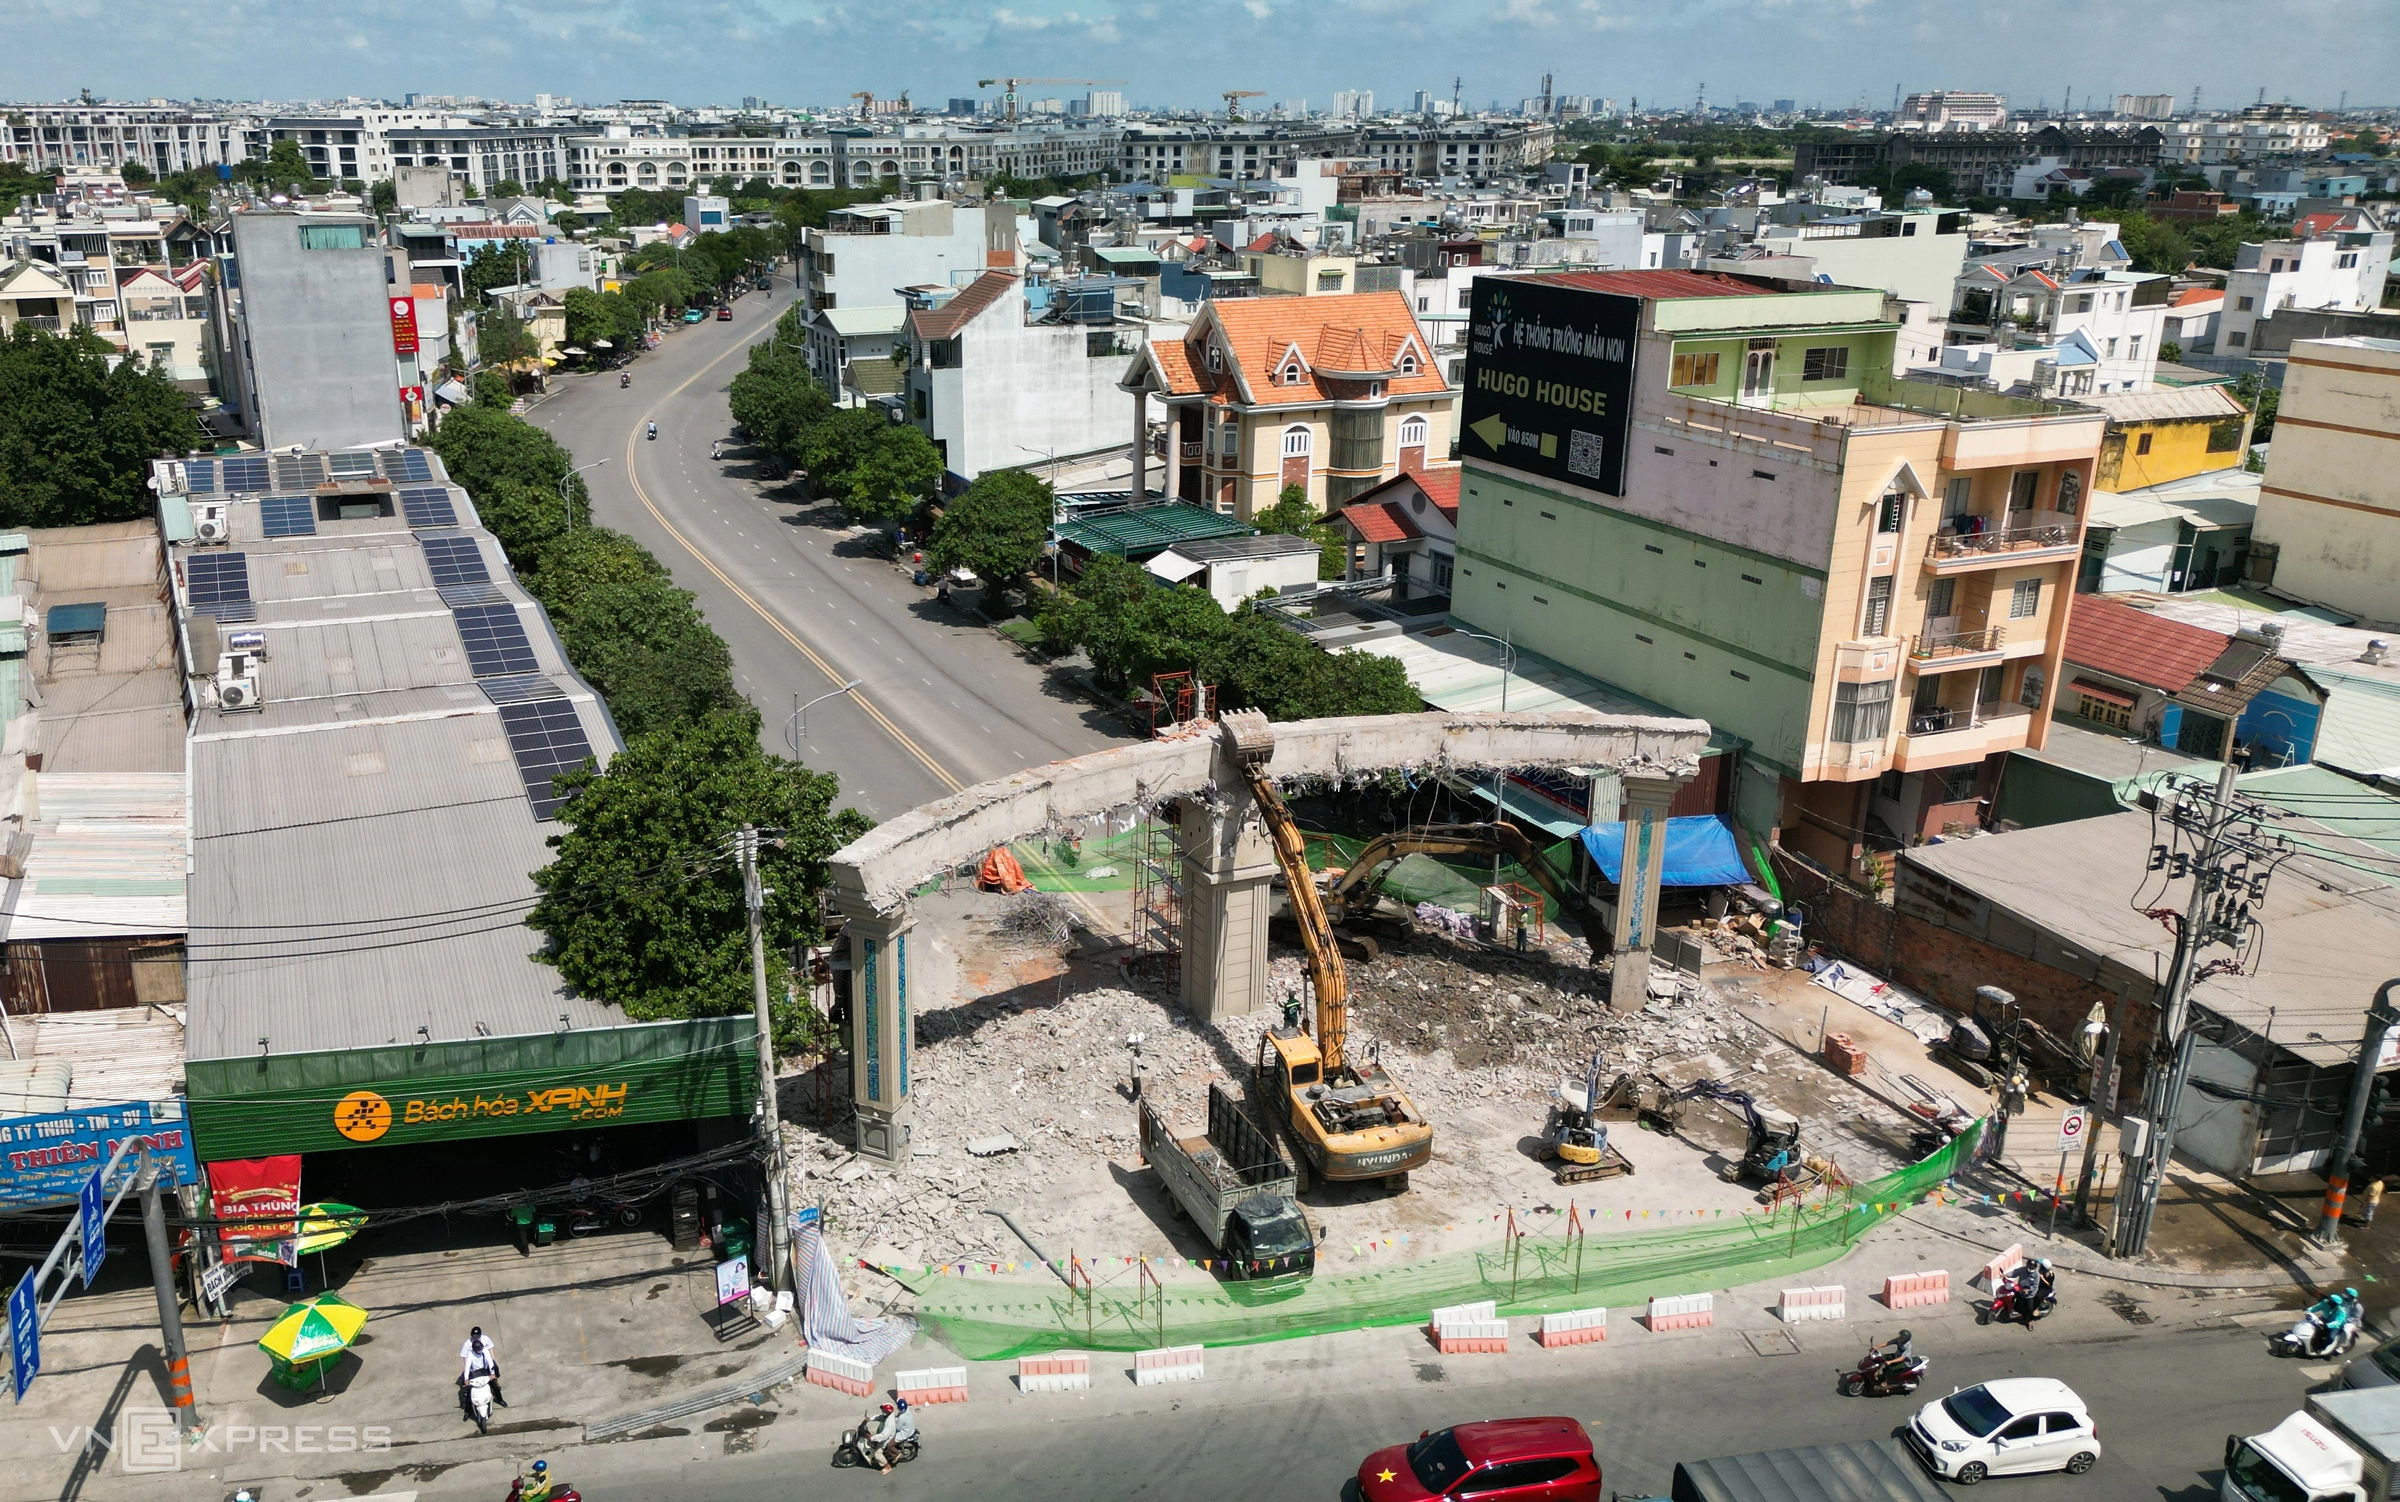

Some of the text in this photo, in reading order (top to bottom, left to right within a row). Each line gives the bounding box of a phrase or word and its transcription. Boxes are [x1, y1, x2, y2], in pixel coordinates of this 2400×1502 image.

[1475, 324, 1491, 338] HUGO
[1513, 314, 1625, 363] HỆ THỐNG TRƯỜNG MẦM NON
[1473, 341, 1493, 355] HOUSE
[1477, 367, 1608, 416] HUGO HOUSE
[1507, 425, 1539, 449] VÀO 850M
[404, 1083, 628, 1123] Bách hóa XANH
[2067, 1107, 2083, 1117] ZONE
[15, 1124, 32, 1141] TY
[35, 1118, 75, 1138] TNHH
[86, 1114, 110, 1132] TM
[122, 1109, 140, 1127] DV
[8, 1140, 99, 1170] THIÊN
[222, 1204, 249, 1214] BIA
